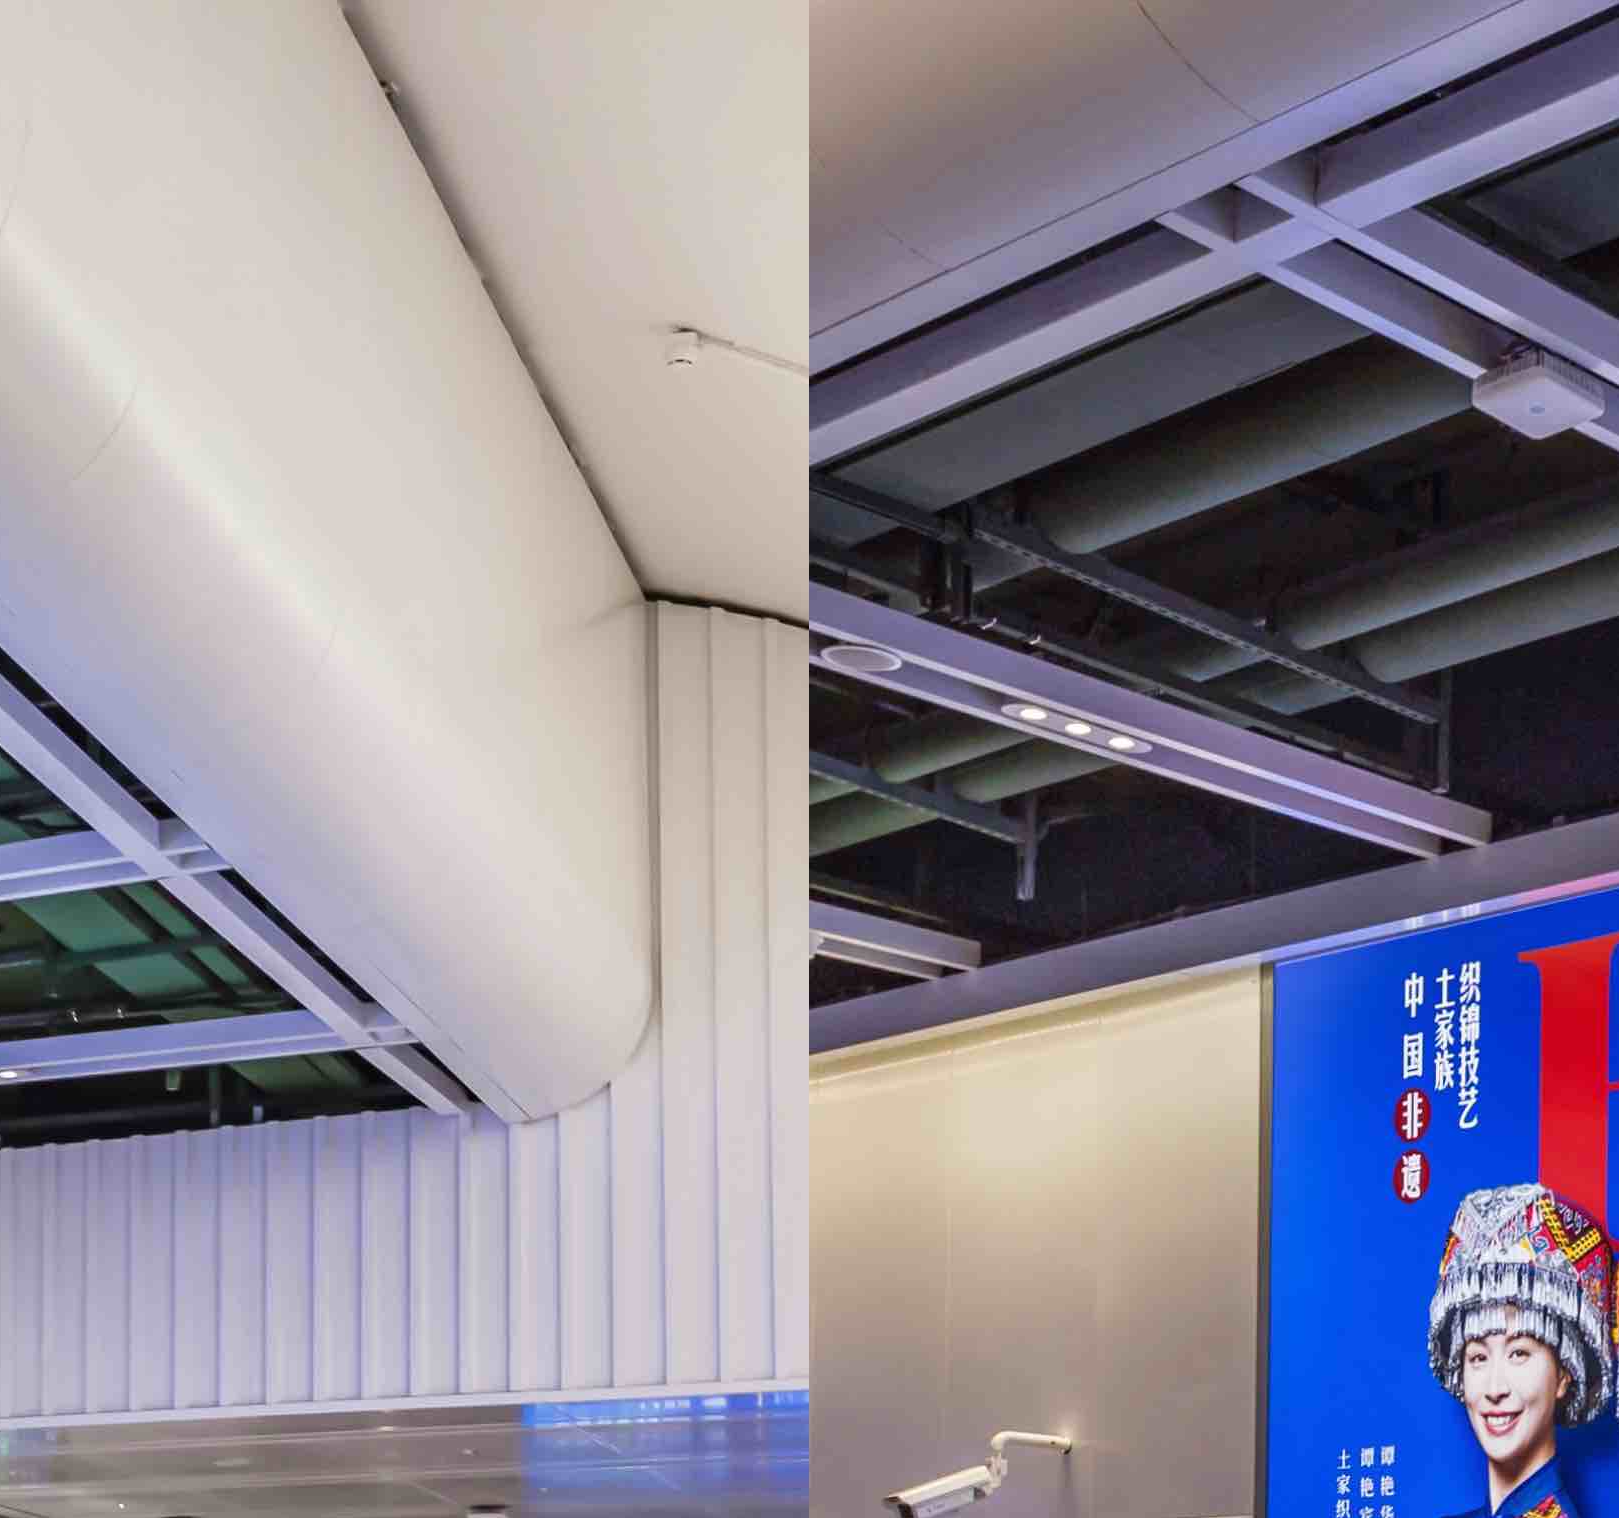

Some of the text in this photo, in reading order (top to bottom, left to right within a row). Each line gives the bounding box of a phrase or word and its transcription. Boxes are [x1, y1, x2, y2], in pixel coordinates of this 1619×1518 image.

[1400, 971, 1424, 1200] 中国非遗
[1434, 967, 1456, 1091] 土家族
[1458, 960, 1482, 1130] 织锦技艺
